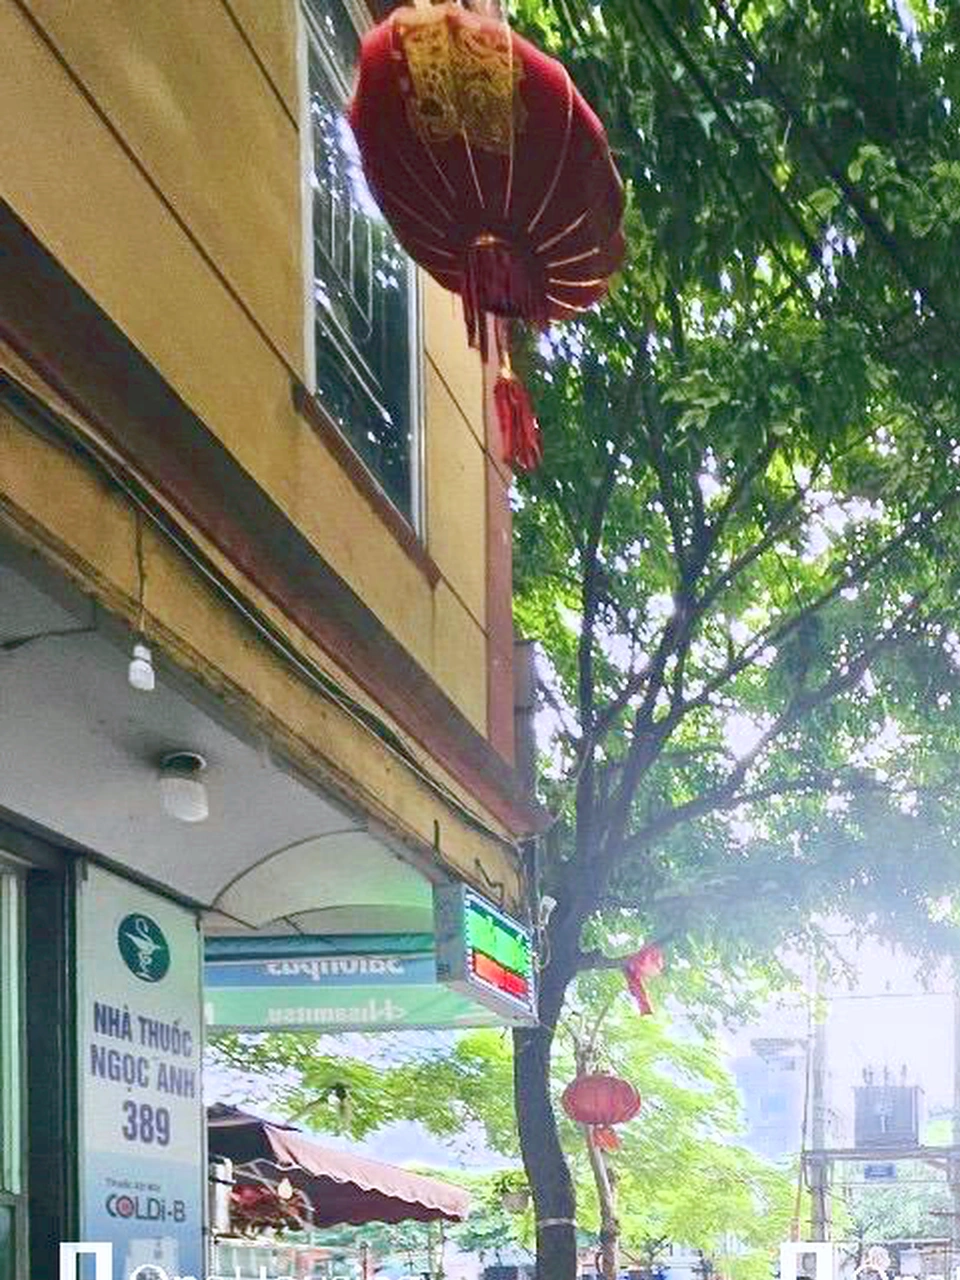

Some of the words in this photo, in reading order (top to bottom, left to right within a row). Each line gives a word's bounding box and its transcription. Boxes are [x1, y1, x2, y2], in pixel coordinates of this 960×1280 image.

[94, 1001, 132, 1042] NHÀ
[138, 1015, 193, 1057] THUỐC
[90, 1044, 149, 1092] NGỌC
[157, 1063, 195, 1099] ANH
[122, 1100, 170, 1146] 389
